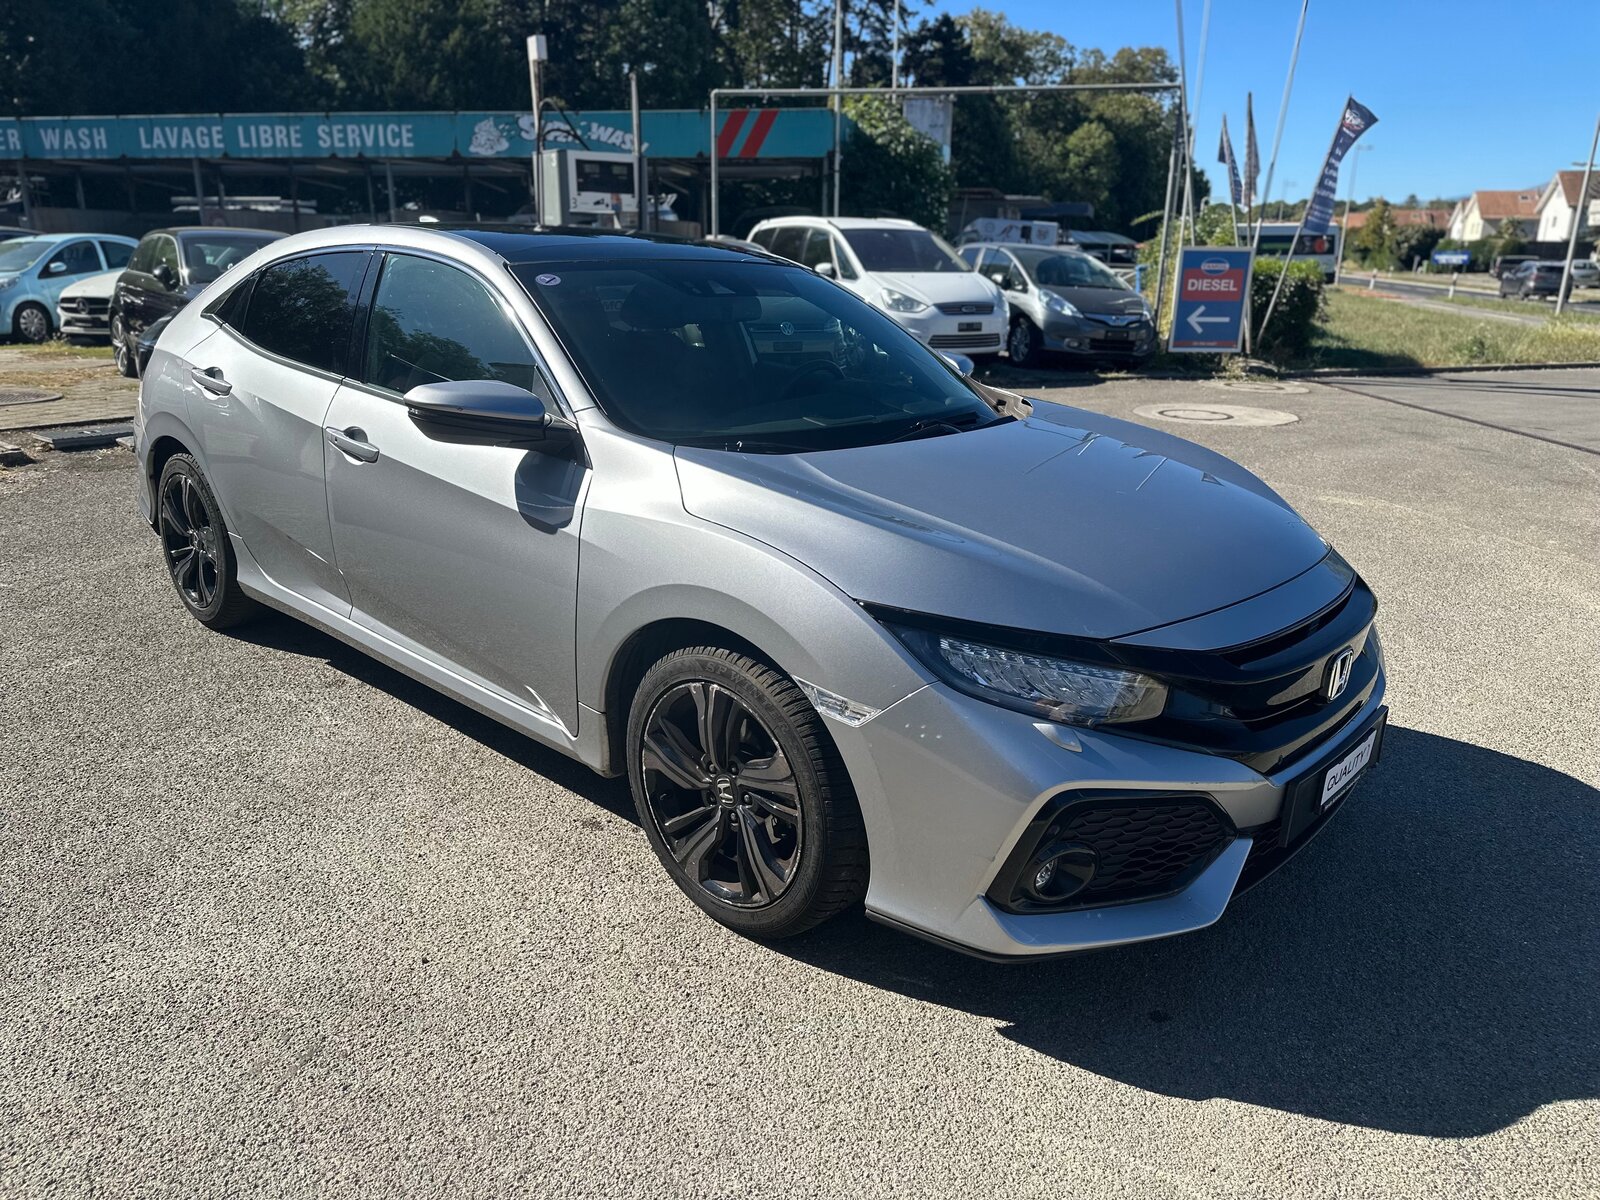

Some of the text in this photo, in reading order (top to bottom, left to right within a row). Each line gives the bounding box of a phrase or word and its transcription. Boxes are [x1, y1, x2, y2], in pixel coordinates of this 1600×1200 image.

[39, 127, 108, 150] WASH
[139, 124, 415, 150] LAVAGE LIBRE SERVICE
[1186, 278, 1238, 293] DIESEL
[1326, 746, 1367, 792] QUALITY
